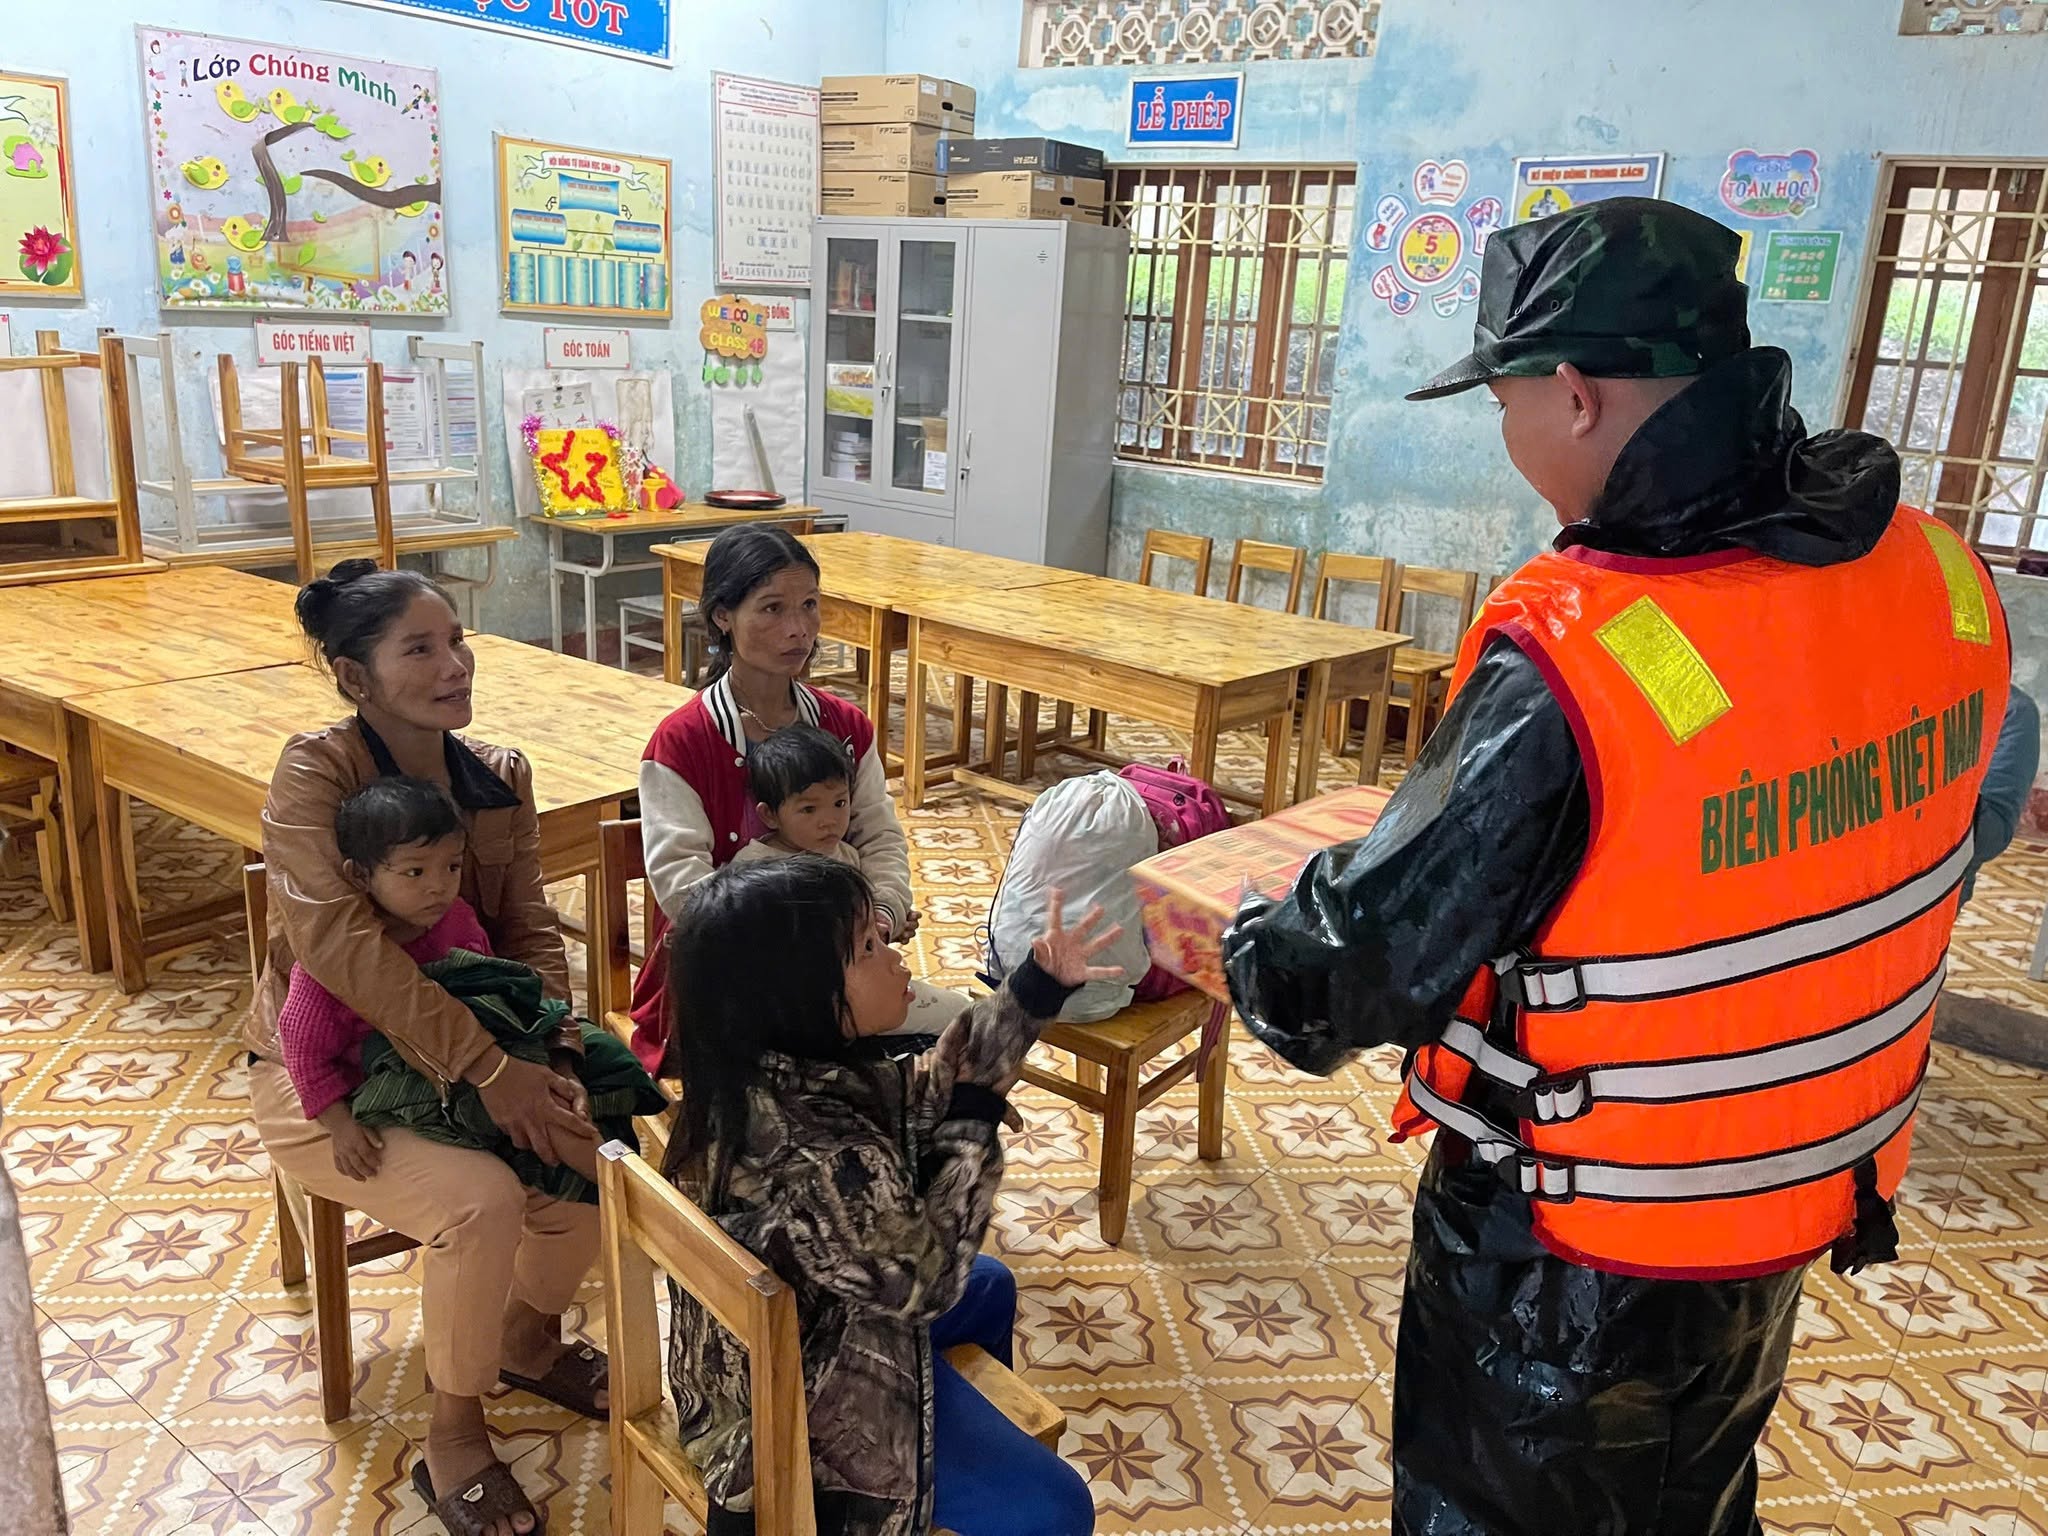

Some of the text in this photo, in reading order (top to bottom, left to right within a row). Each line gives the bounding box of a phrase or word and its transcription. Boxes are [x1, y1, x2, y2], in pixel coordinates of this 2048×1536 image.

[193, 54, 396, 106] Lớp Chúng Mình
[1137, 87, 1231, 130] LỄ PHÉP
[1424, 235, 1438, 254] 5
[707, 305, 763, 327] WELCOME
[272, 329, 355, 355] GÓC TIẾNG VIỆT
[563, 339, 611, 358] GÓC TOÁN
[710, 332, 764, 354] CLASS 4B
[1700, 688, 1985, 875] BIÊN PHÒNG VIỆT NAM
